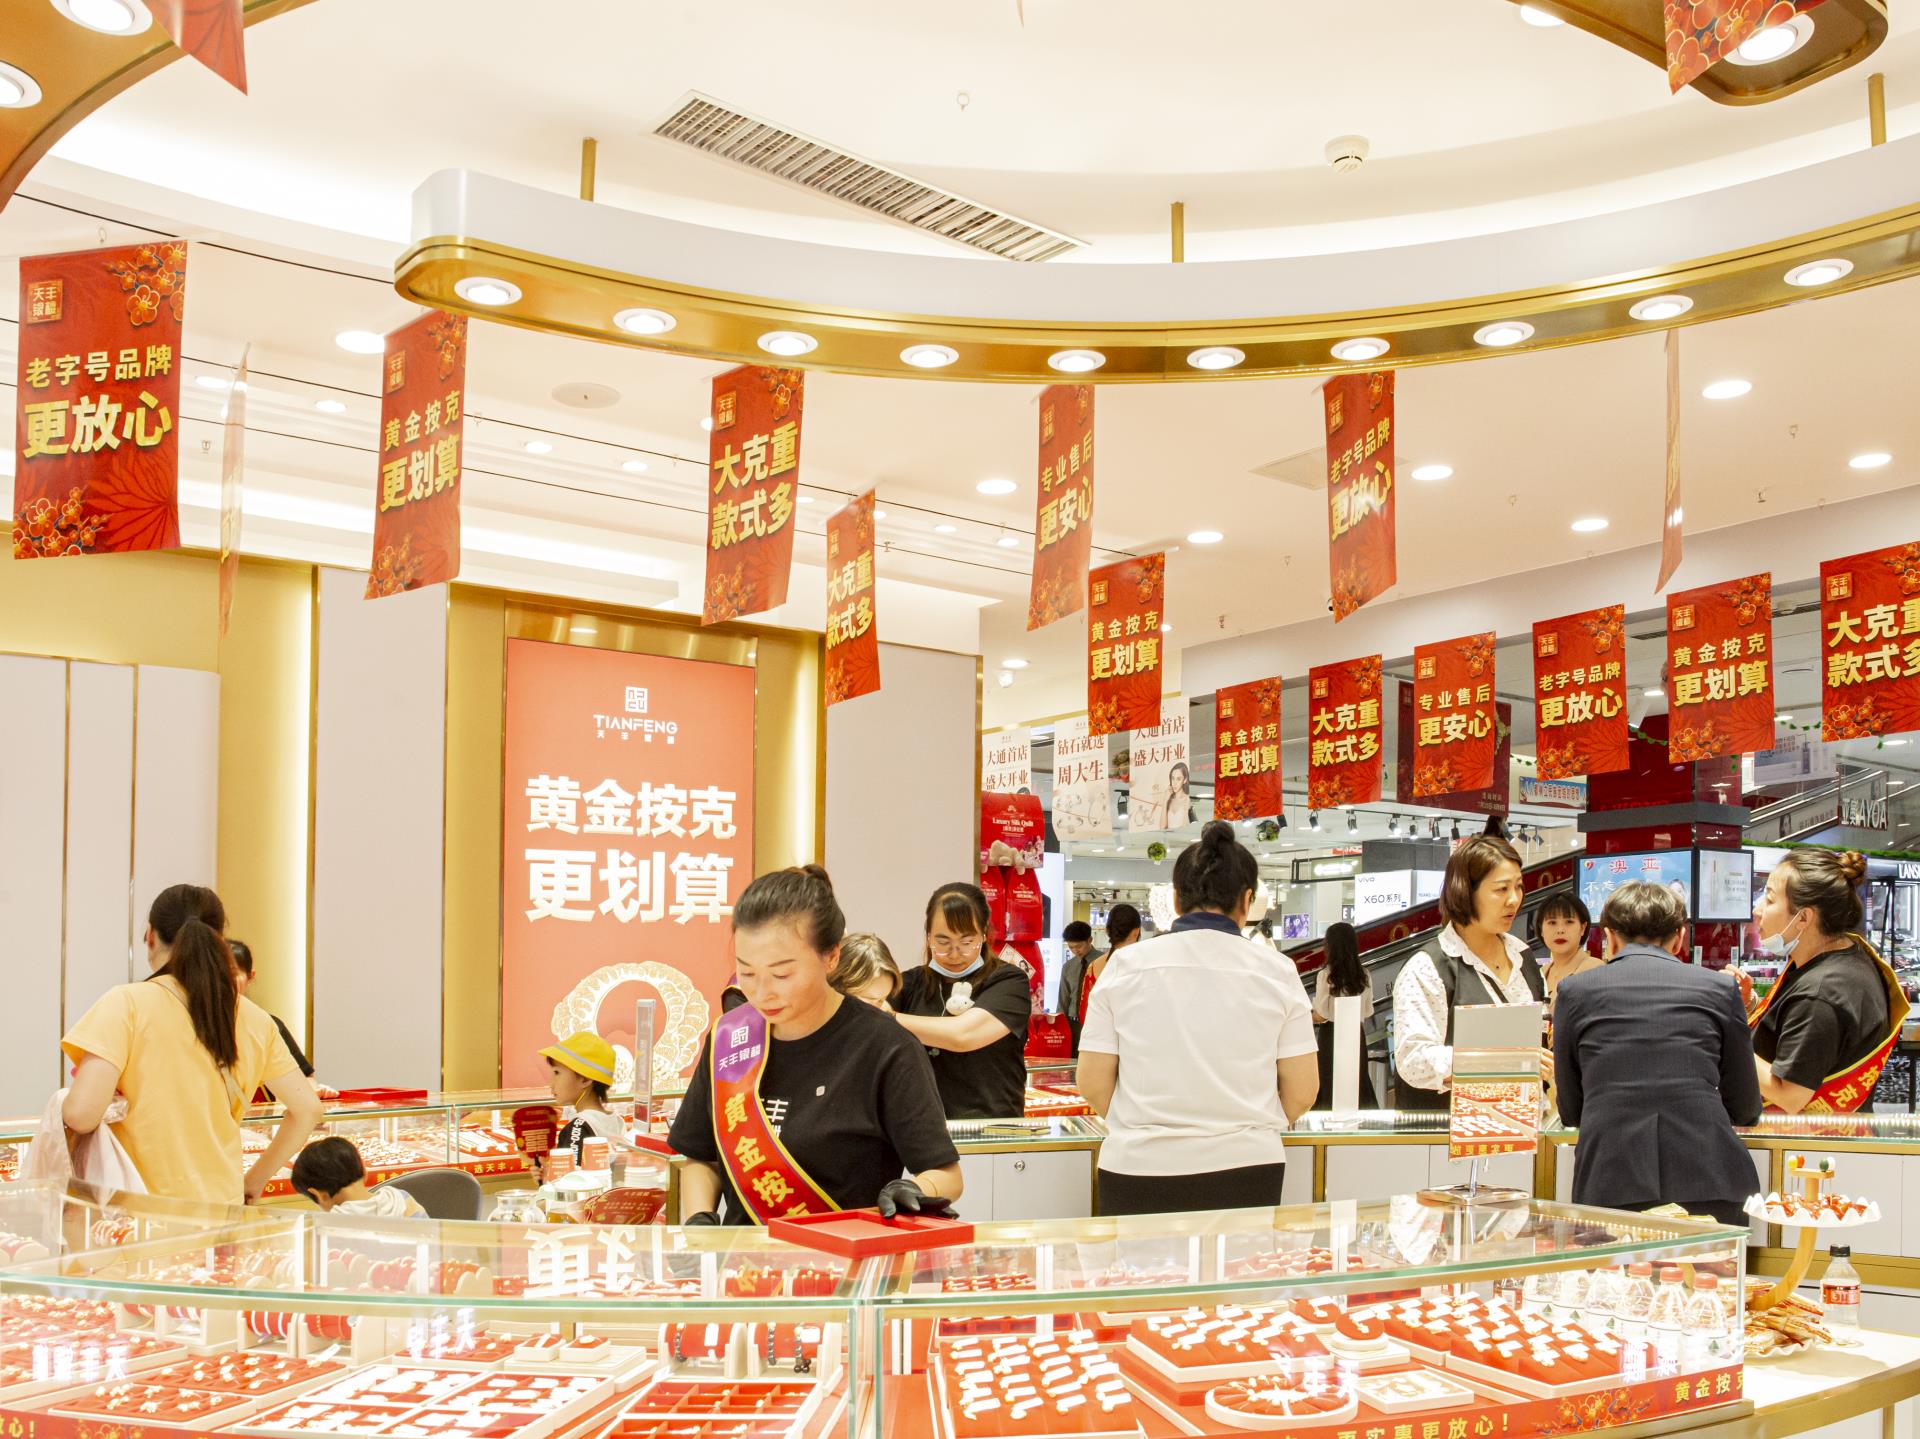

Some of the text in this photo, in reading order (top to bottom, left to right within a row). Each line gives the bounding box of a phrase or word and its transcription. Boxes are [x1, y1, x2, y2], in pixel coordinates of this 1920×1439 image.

[25, 345, 172, 385] 老字号品牌
[23, 391, 172, 458] 更放心
[385, 390, 460, 450] 黄金按克
[714, 421, 797, 494] 大克重
[1041, 430, 1093, 492] 专业售后
[1330, 417, 1390, 484] 老字号品牌
[381, 433, 460, 513] 更划算
[712, 482, 793, 550] 款式多
[1039, 484, 1093, 551] 更安心
[1331, 460, 1392, 541] 更放心
[828, 551, 873, 606] 大克重
[827, 599, 873, 650] 款式多
[1091, 611, 1159, 642] 黄金按克
[1091, 637, 1160, 681] 更划算
[1673, 632, 1767, 668] 黄金按克
[1418, 684, 1491, 711] 专业售后
[1538, 661, 1621, 692] 老字号品牌
[1673, 660, 1769, 707] 更划算
[593, 714, 678, 735] TIANFENG
[1313, 699, 1380, 736] 大克重
[1418, 709, 1492, 747] 更安心
[1539, 687, 1623, 729] 更放心
[986, 745, 1028, 766] 大通首店
[1134, 743, 1185, 767] 盛大开业
[1219, 723, 1278, 748] 黄金按克
[1312, 732, 1380, 768] 款式多
[986, 769, 1028, 790] 盛大开业
[1058, 760, 1104, 785] 周大生
[1219, 744, 1279, 779] 更划算
[525, 774, 737, 840] 黄金按克
[524, 848, 735, 925] 更划算
